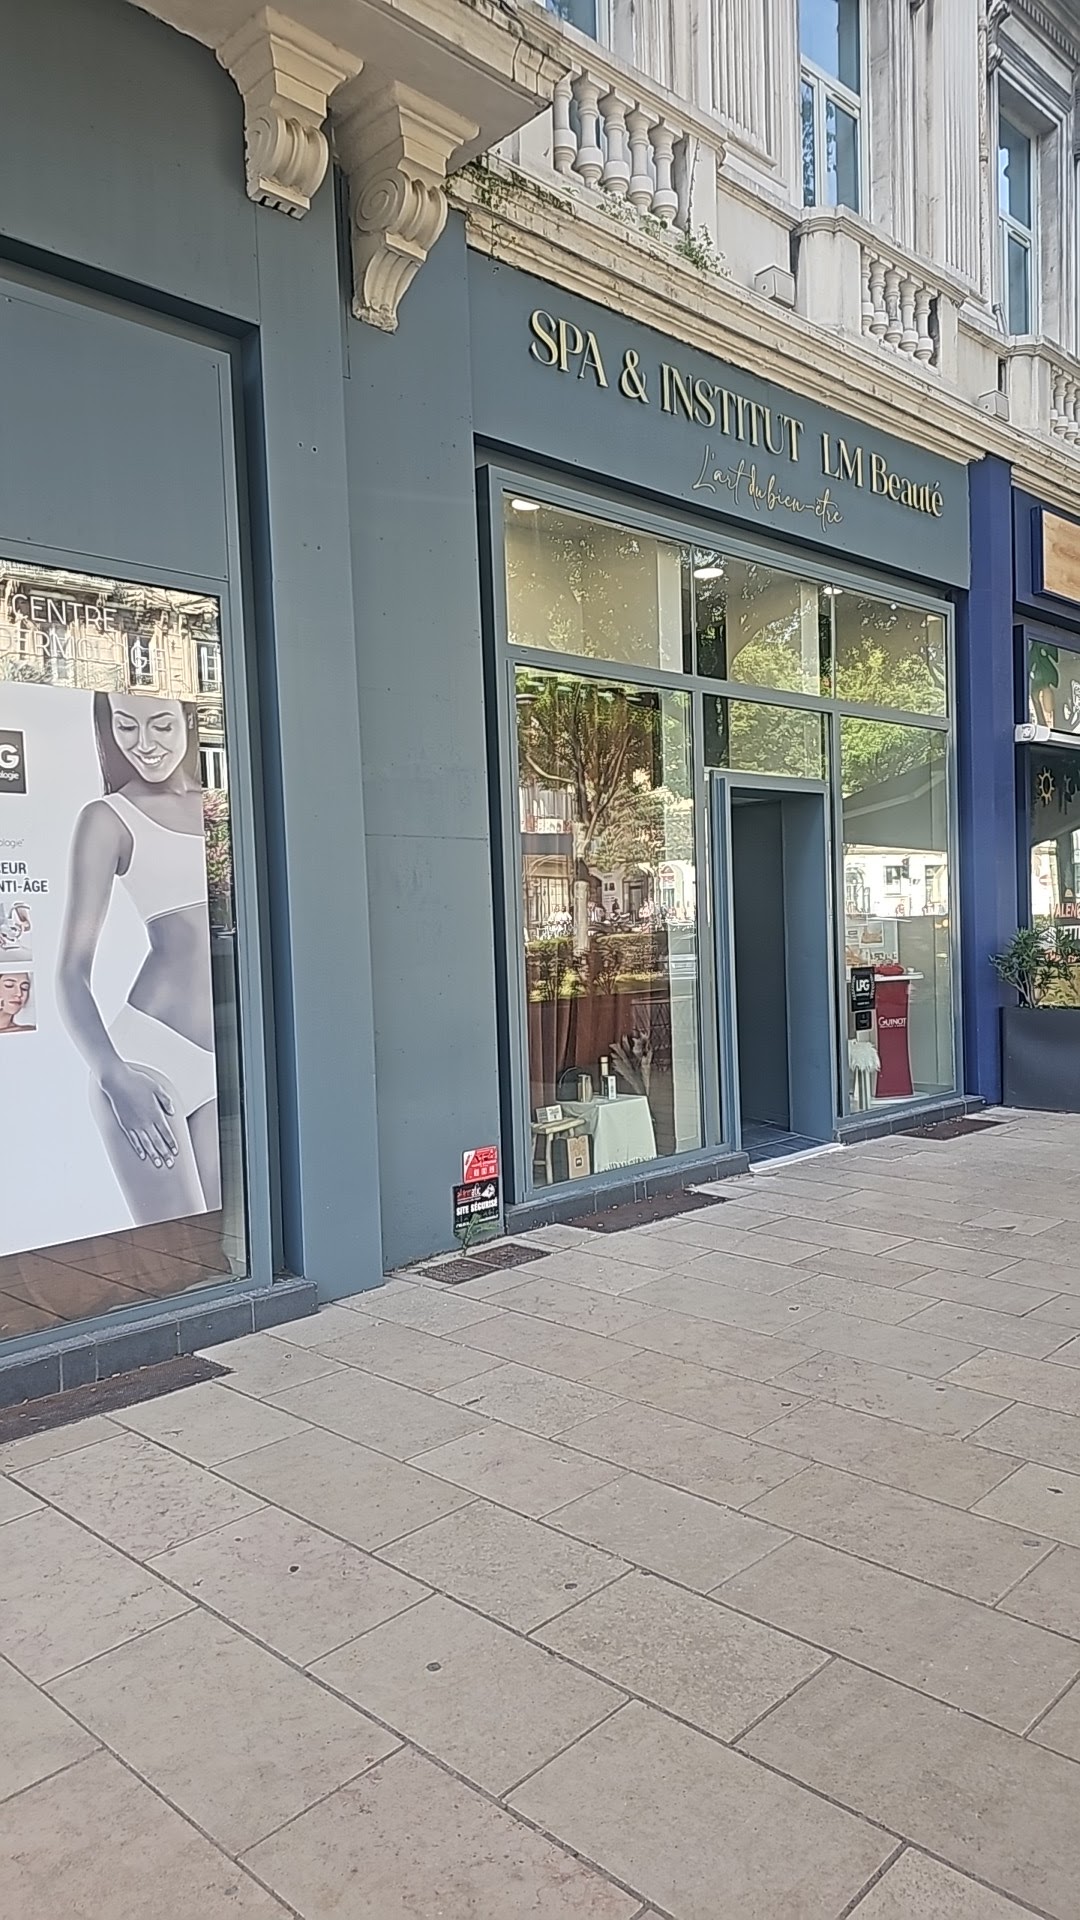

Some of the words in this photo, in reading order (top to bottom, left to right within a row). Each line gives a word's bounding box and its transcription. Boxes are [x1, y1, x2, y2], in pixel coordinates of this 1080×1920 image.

[529, 309, 609, 388] SPA
[620, 349, 650, 404] &
[660, 362, 805, 462] INSTITUT
[821, 432, 864, 488] LM
[870, 452, 944, 518] Beauté
[692, 444, 752, 505] L'art
[12, 593, 117, 633] CENTRE
[0, 862, 27, 875] EUR
[855, 979, 870, 992] LPG
